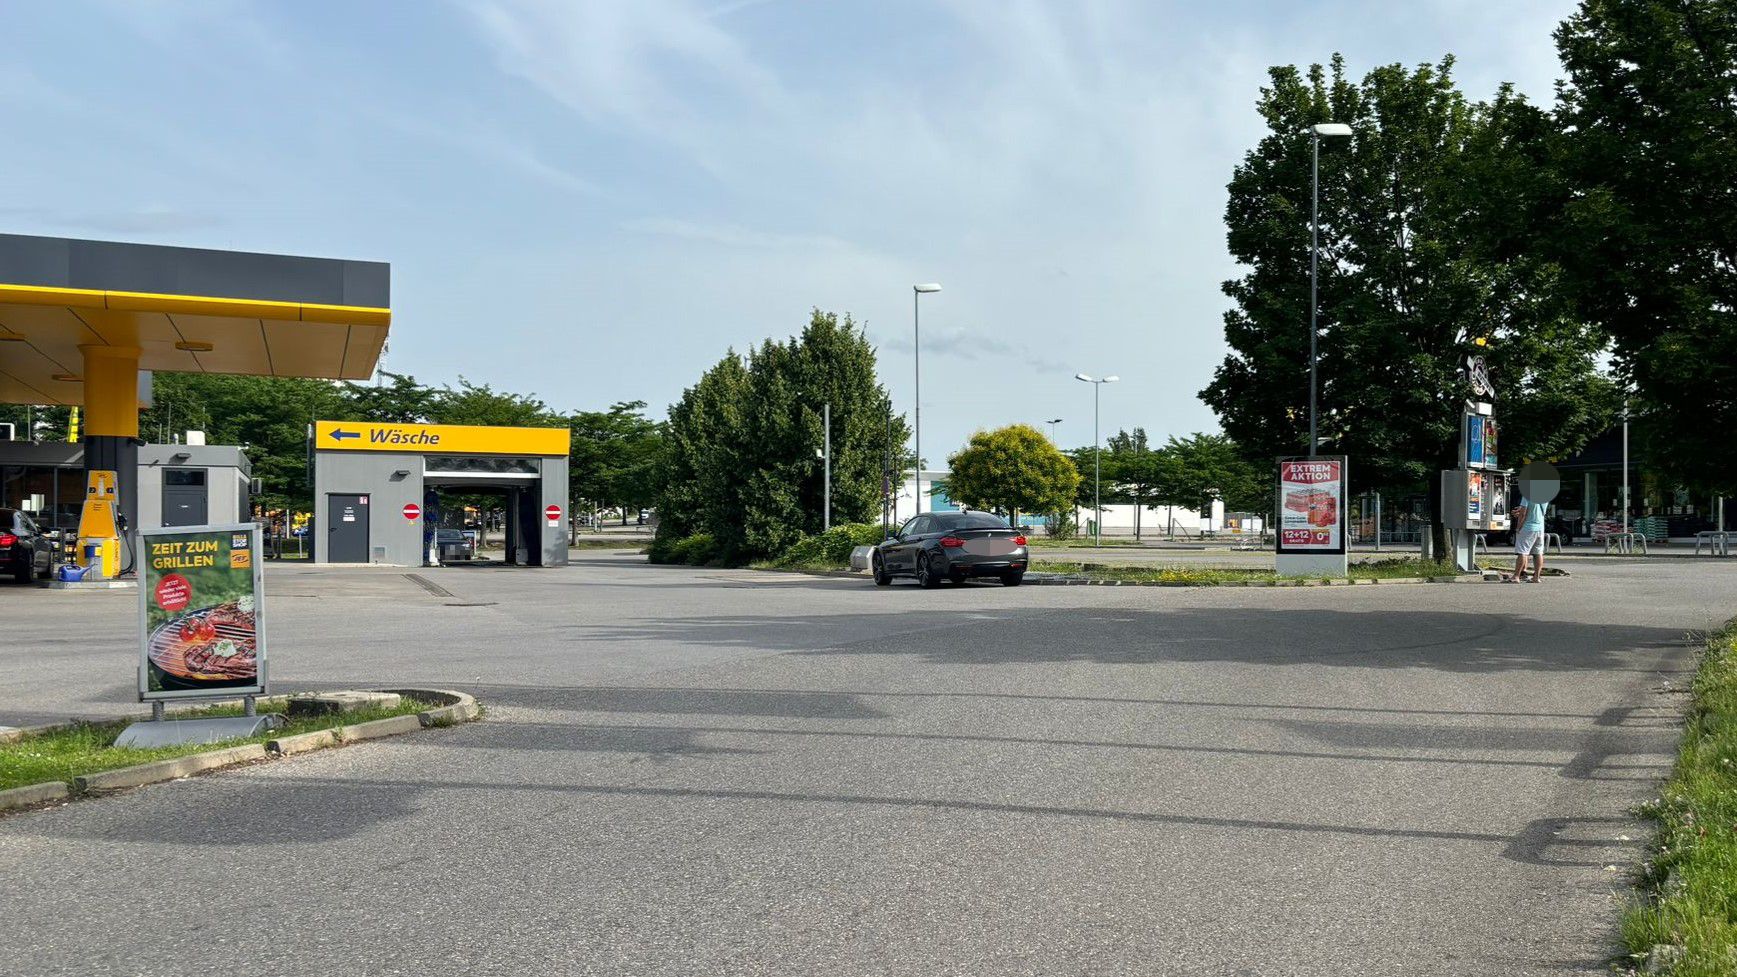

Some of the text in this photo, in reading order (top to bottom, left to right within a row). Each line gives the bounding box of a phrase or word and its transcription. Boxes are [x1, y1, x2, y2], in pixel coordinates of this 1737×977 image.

[370, 429, 440, 445] Wäsche
[1290, 464, 1331, 473] EXTREM
[1291, 472, 1331, 480] AKTION
[1284, 530, 1309, 539] 12+12
[152, 540, 218, 555] ZEIT ZUM
[153, 555, 214, 569] GRILLEN
